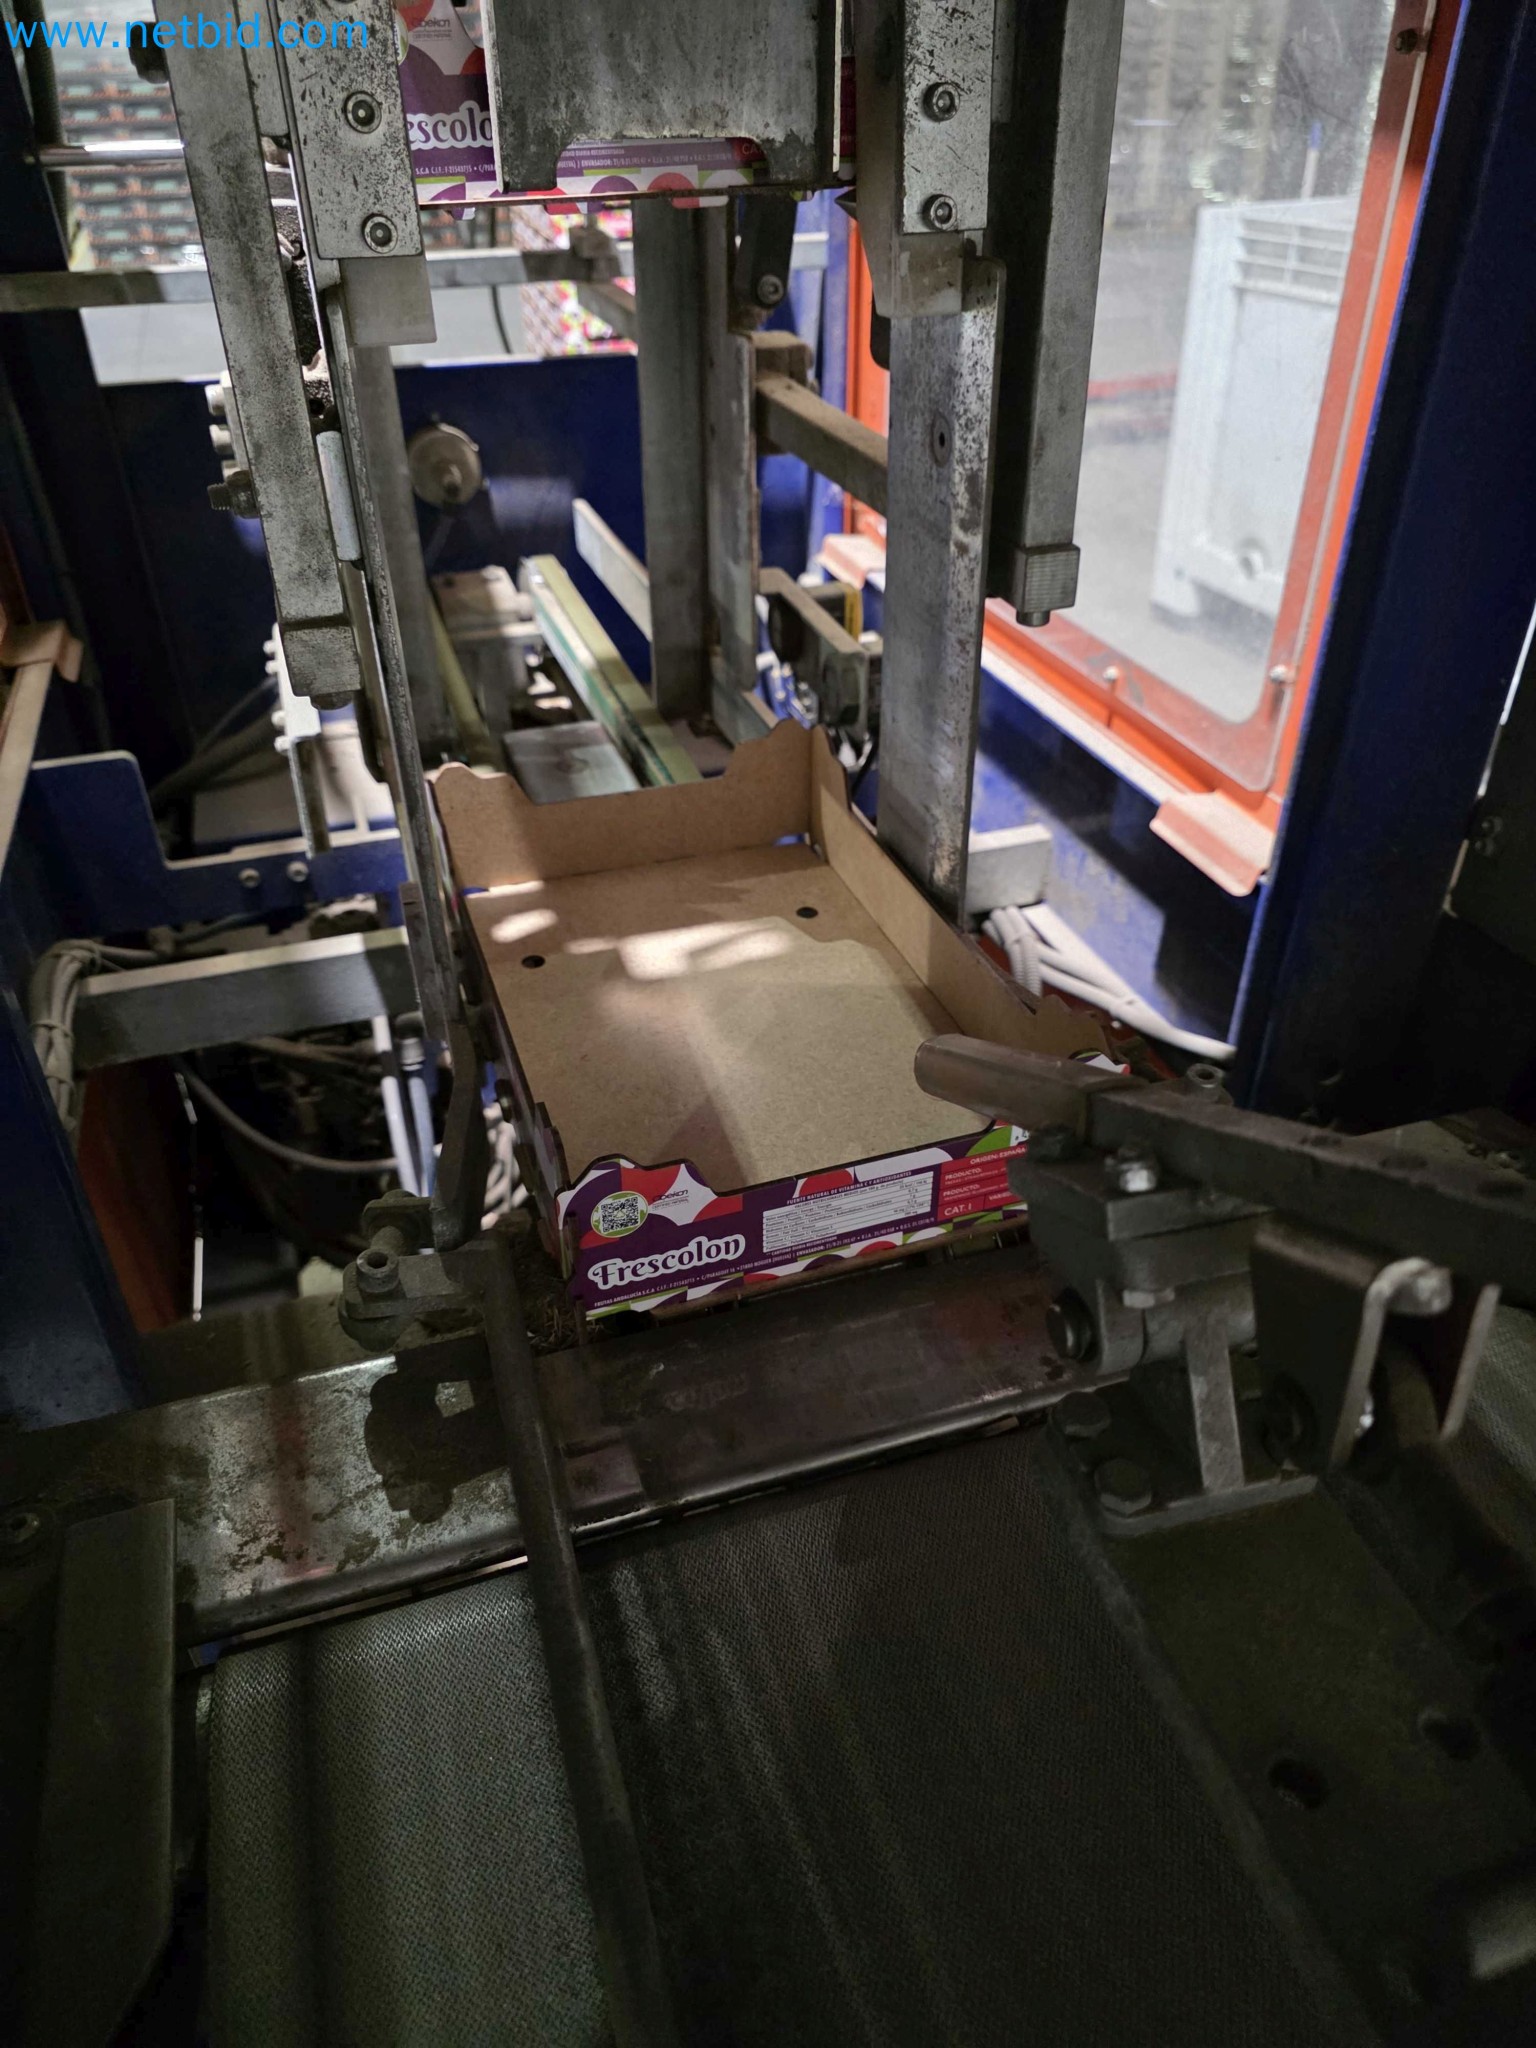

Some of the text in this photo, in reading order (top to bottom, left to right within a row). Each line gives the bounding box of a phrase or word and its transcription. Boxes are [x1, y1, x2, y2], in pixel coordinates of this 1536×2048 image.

[999, 1147, 1027, 1158] ESPAÑA
[787, 1195, 807, 1205] FUENTE
[807, 1191, 831, 1201] NATURAL
[838, 1182, 864, 1194] VITAMINA
[873, 1171, 912, 1185] ANTIOXIDANTES
[591, 1236, 742, 1287] Frescolon
[594, 1298, 613, 1308] FRUTAS
